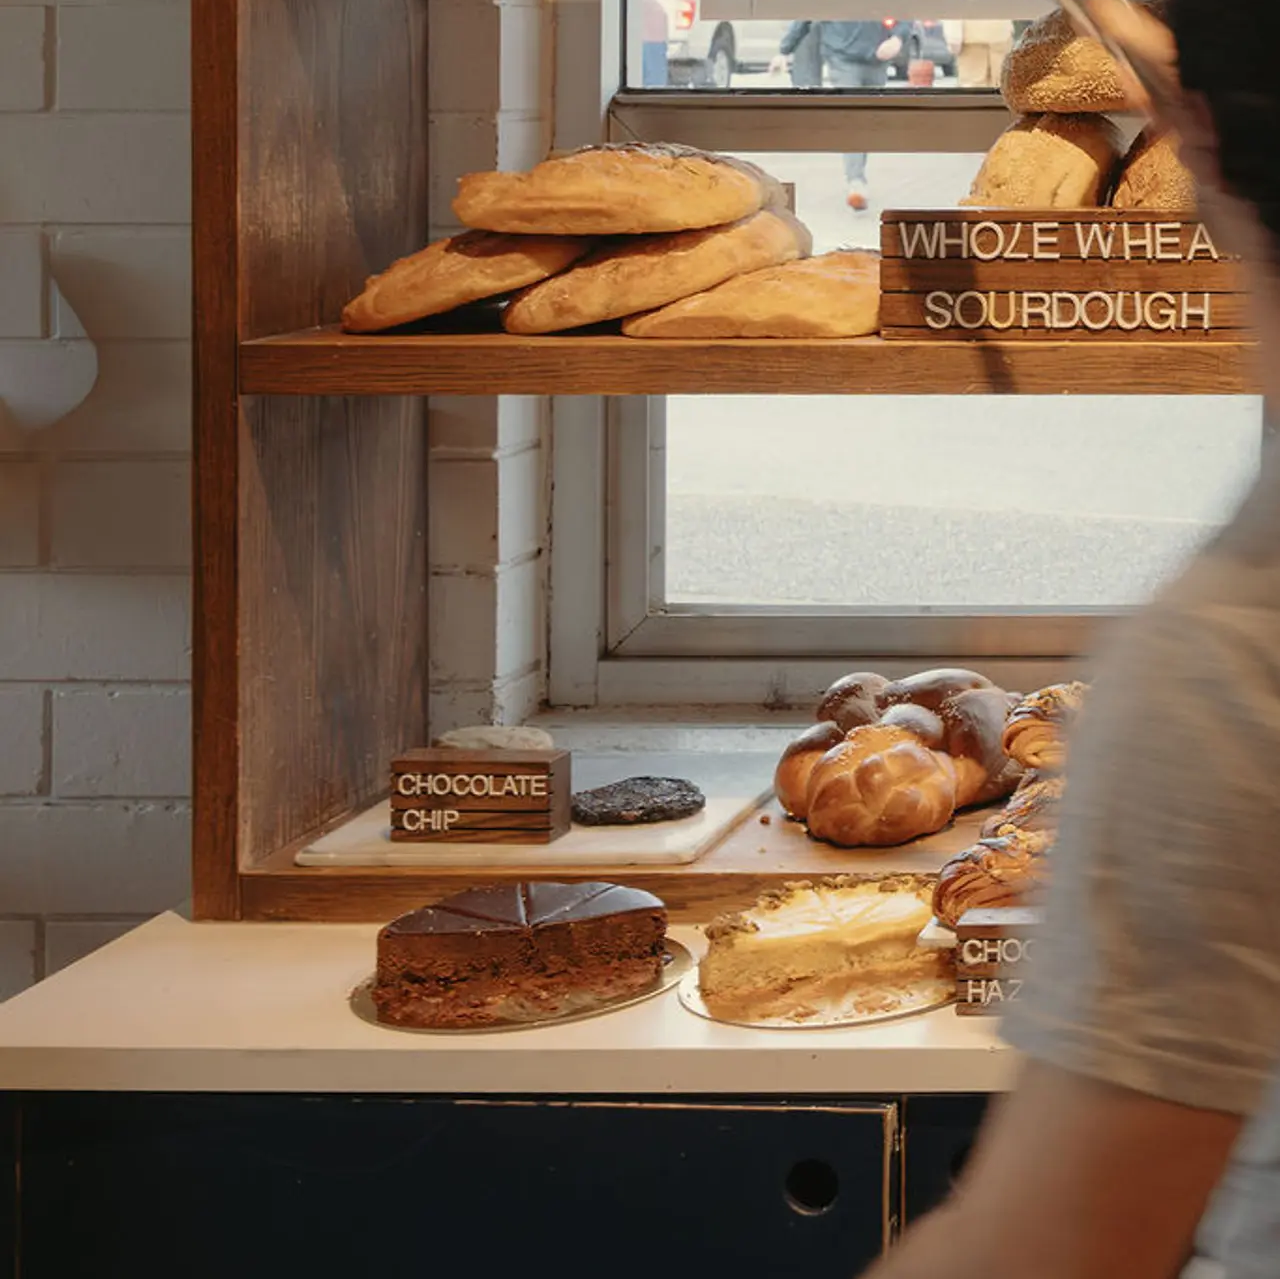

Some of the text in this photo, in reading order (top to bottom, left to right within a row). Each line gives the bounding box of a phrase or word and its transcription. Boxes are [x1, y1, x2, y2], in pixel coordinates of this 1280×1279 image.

[898, 221, 1219, 261] WHOLE WHEA
[924, 290, 1212, 333] SOURDOUGH
[399, 774, 548, 797] CHOCOLATE
[402, 809, 460, 832] CHIP
[962, 938, 1036, 964] CHOC
[967, 978, 1024, 1006] HAZ
